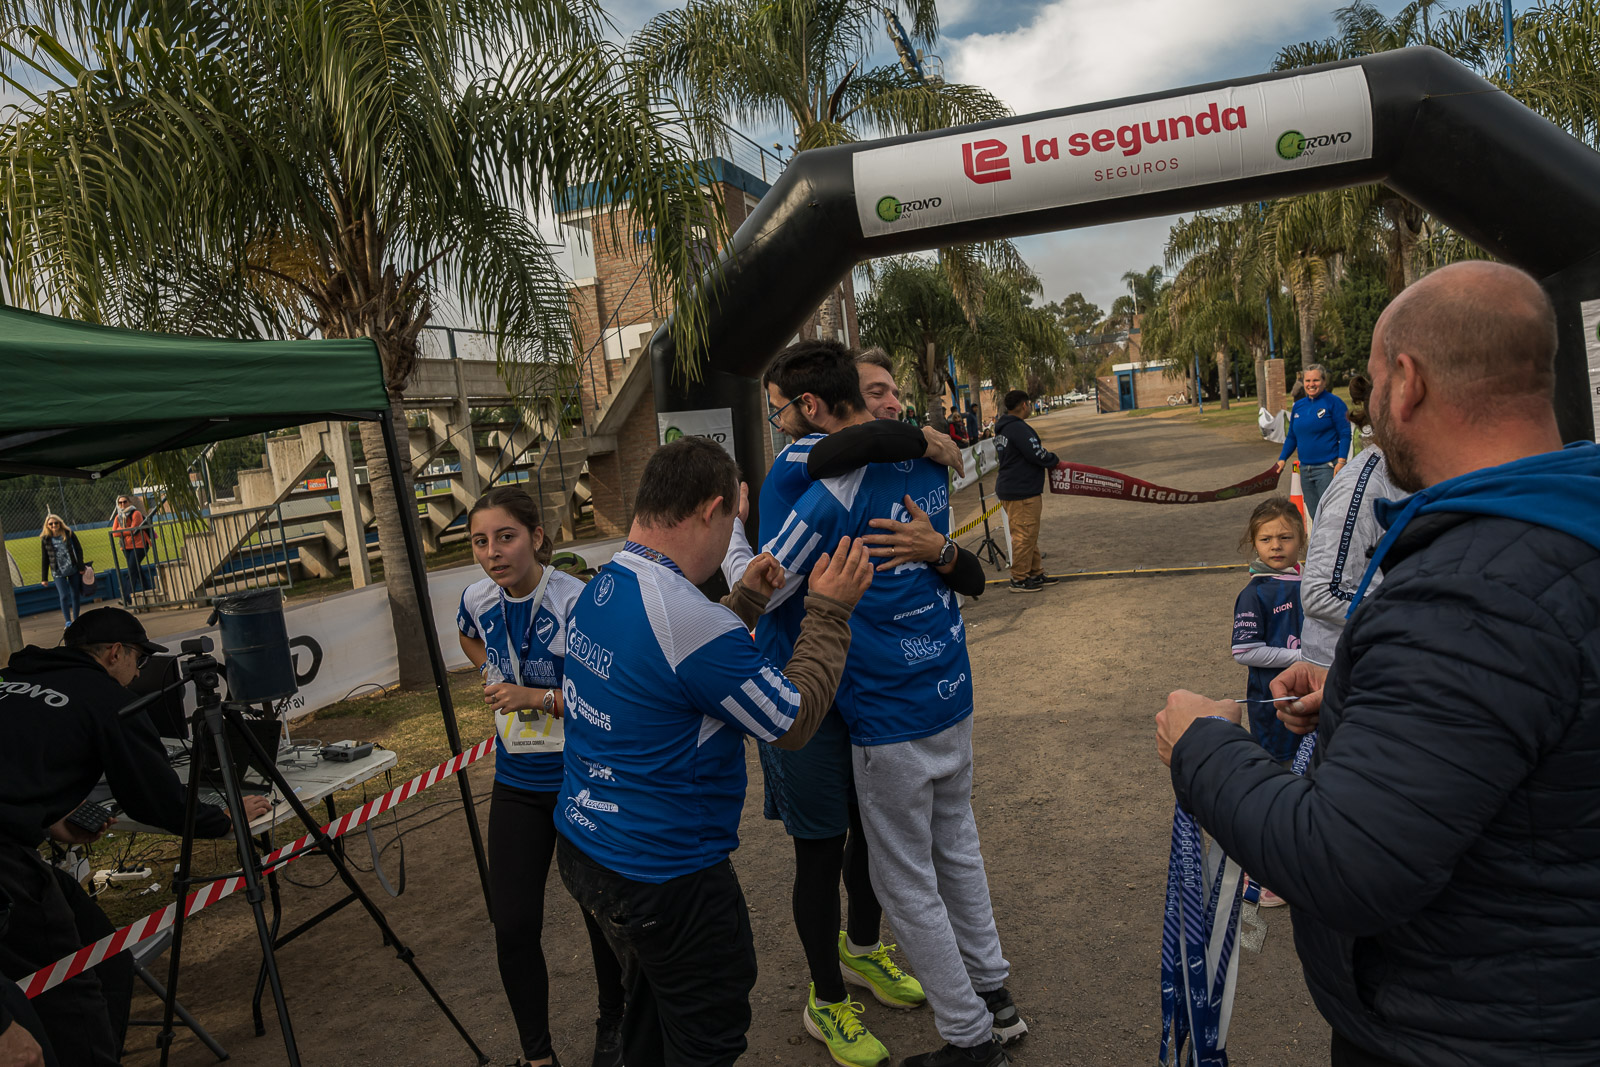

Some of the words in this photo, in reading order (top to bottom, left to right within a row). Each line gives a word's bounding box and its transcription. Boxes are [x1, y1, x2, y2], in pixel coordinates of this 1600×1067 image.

[1021, 134, 1060, 164] la
[1068, 102, 1248, 157] segunda
[1094, 157, 1180, 182] SEGUROS
[1053, 480, 1071, 490] VOS
[1131, 484, 1199, 502] LLEGADA
[1273, 602, 1293, 614] KION
[567, 626, 613, 679] CEDAR
[577, 704, 612, 731] AREQUITO
[578, 696, 600, 718] COMUNA
[600, 711, 611, 723] DE
